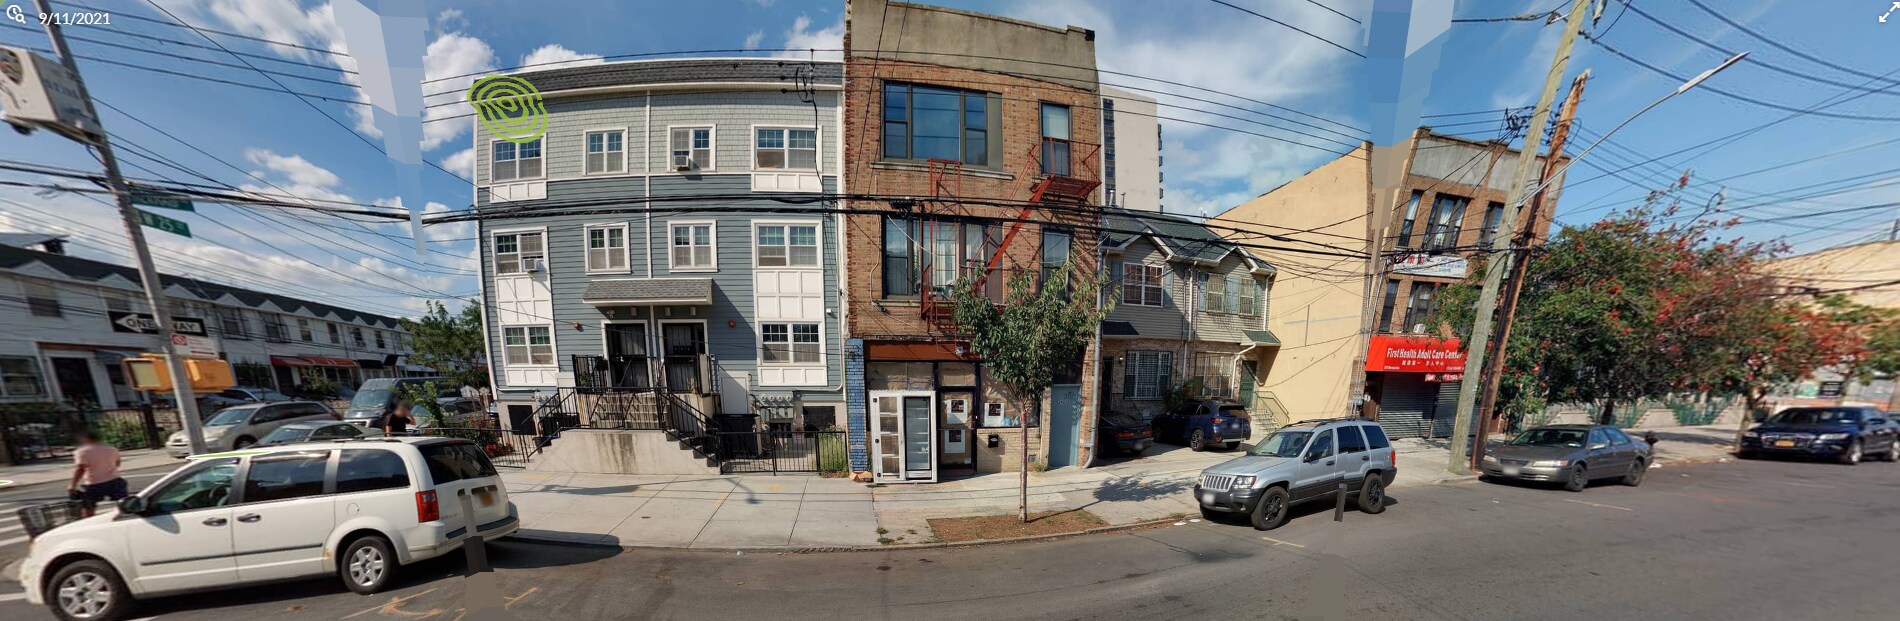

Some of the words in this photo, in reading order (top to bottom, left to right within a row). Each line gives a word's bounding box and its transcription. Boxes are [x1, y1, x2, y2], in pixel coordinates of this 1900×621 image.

[126, 317, 157, 332] ONE
[1386, 347, 1400, 358] First
[1400, 348, 1417, 359] Health
[1417, 349, 1432, 360] Adult
[1432, 349, 1444, 360] Care
[1444, 349, 1463, 360] Center
